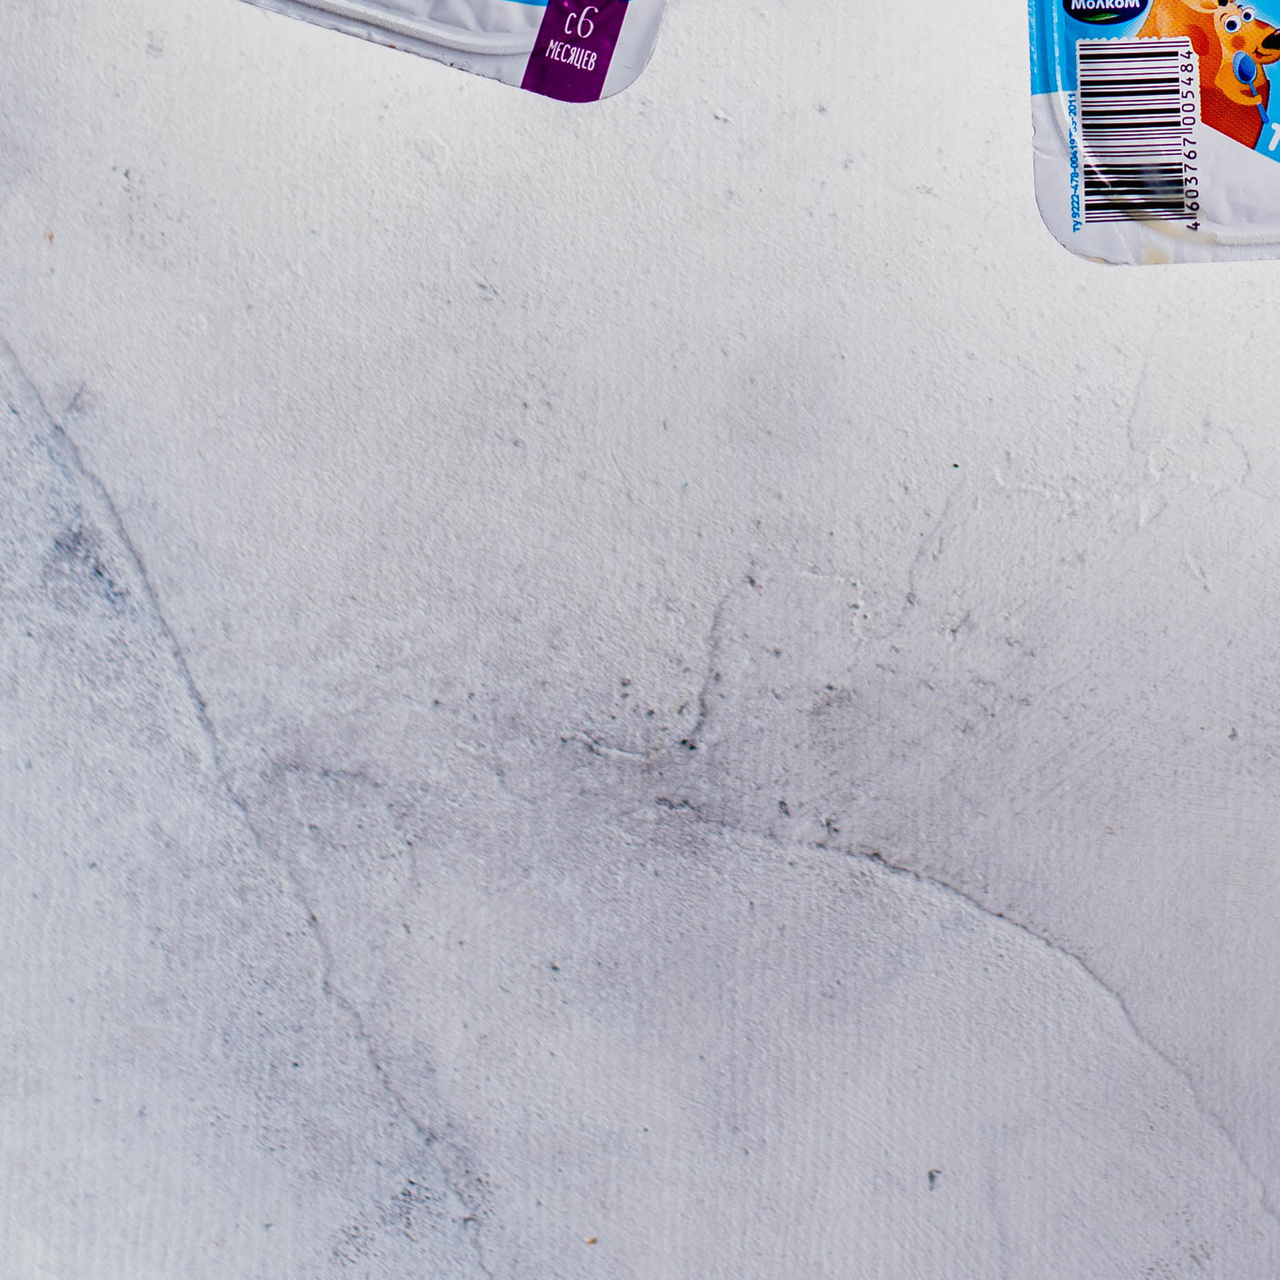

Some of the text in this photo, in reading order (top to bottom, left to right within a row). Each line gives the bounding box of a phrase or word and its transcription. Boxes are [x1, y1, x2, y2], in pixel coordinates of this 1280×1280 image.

[545, 39, 598, 72] МЕСЯЦЕВ
[1180, 50, 1200, 232] 4 603767 005484
